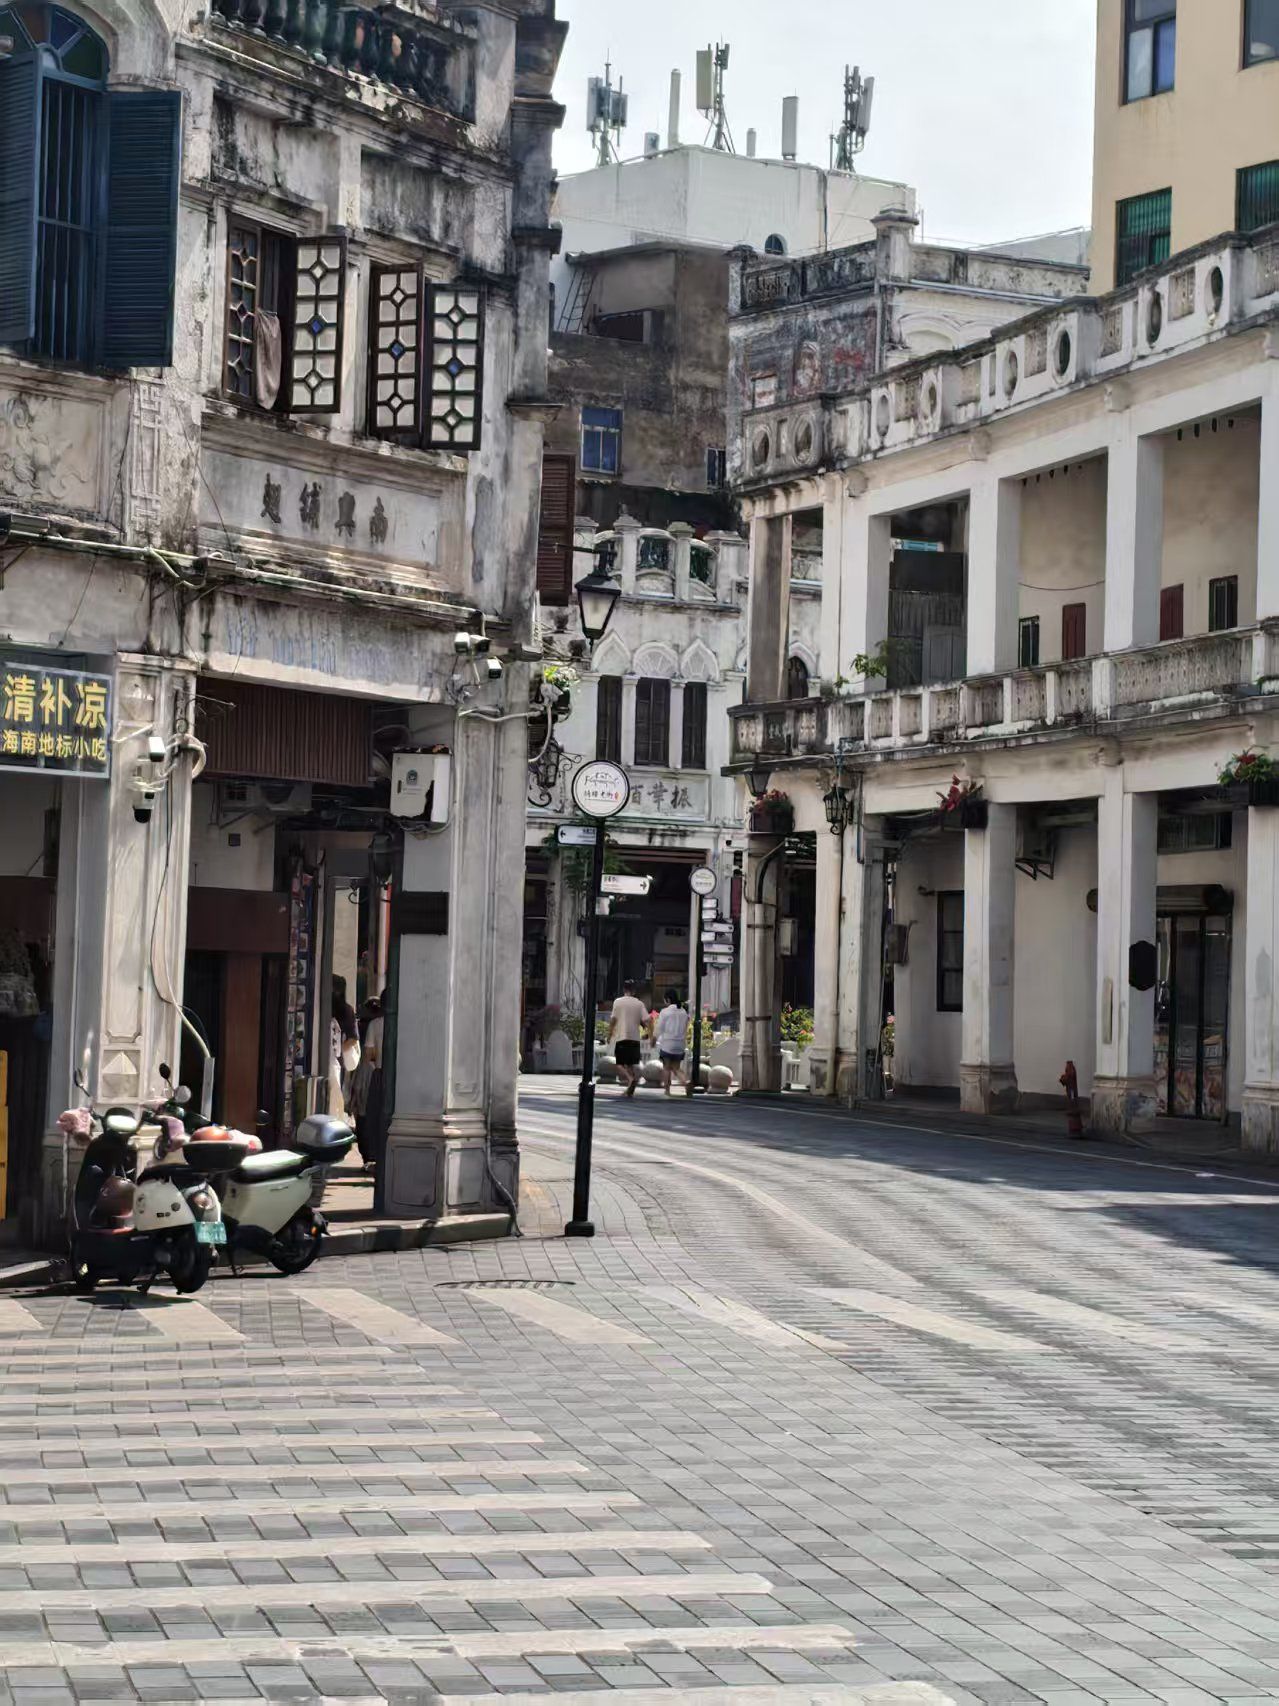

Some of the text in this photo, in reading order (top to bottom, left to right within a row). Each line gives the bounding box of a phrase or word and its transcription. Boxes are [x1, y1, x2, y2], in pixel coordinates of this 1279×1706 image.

[4, 673, 107, 728] 清补凉
[2, 729, 106, 761] 海南地标小吃
